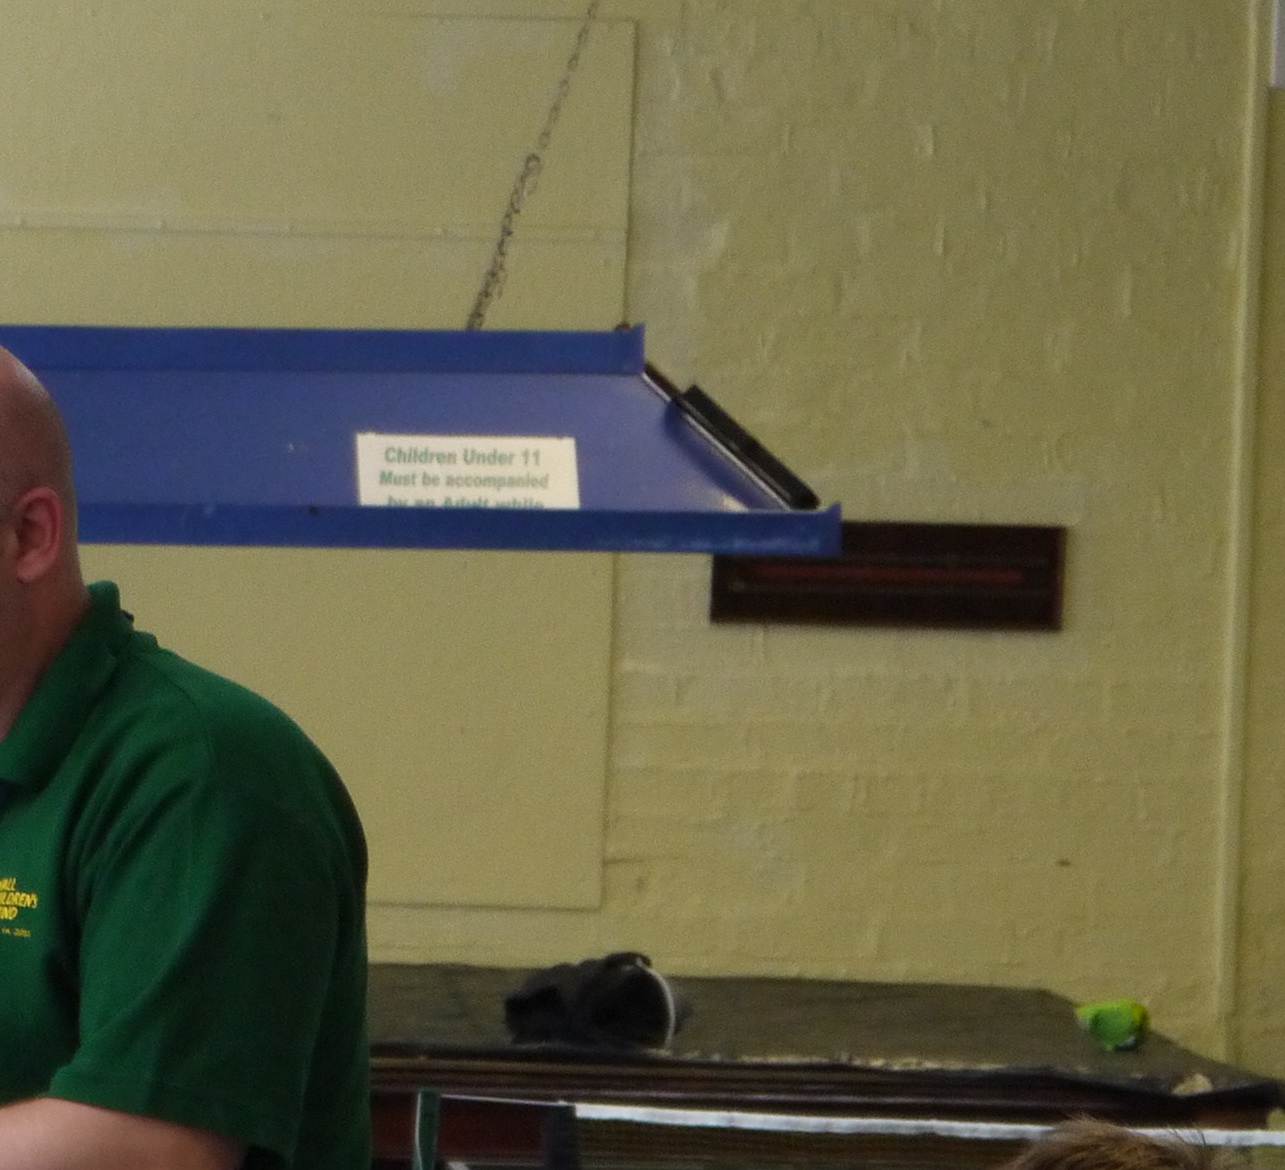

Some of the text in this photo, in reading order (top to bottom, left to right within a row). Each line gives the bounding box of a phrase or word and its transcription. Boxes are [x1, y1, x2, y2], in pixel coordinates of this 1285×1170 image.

[384, 446, 541, 466] Children Under 11
[379, 470, 549, 491] Must be accompanied
